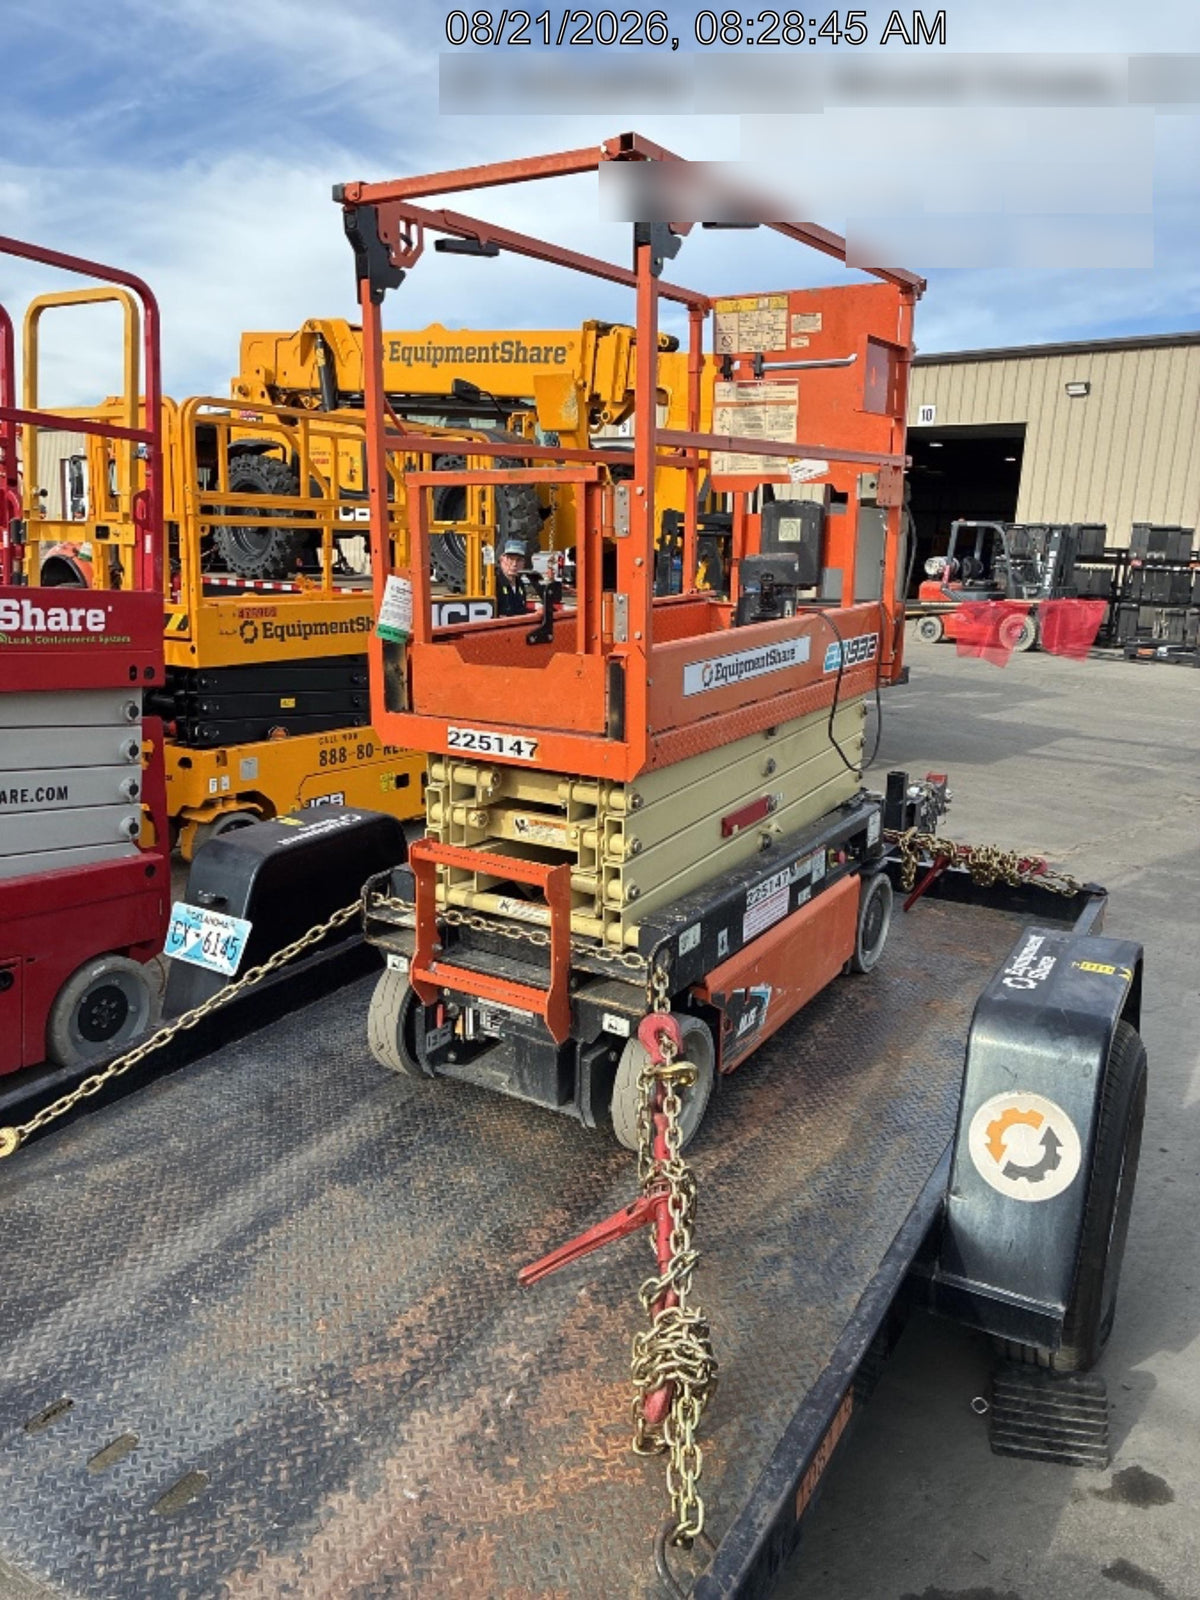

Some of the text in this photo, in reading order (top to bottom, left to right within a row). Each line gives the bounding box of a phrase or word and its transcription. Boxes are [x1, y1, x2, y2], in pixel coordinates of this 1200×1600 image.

[388, 340, 567, 368] EquipmentShare
[922, 408, 933, 421] 10
[714, 646, 796, 682] EquipmentShare
[447, 730, 539, 758] 225147
